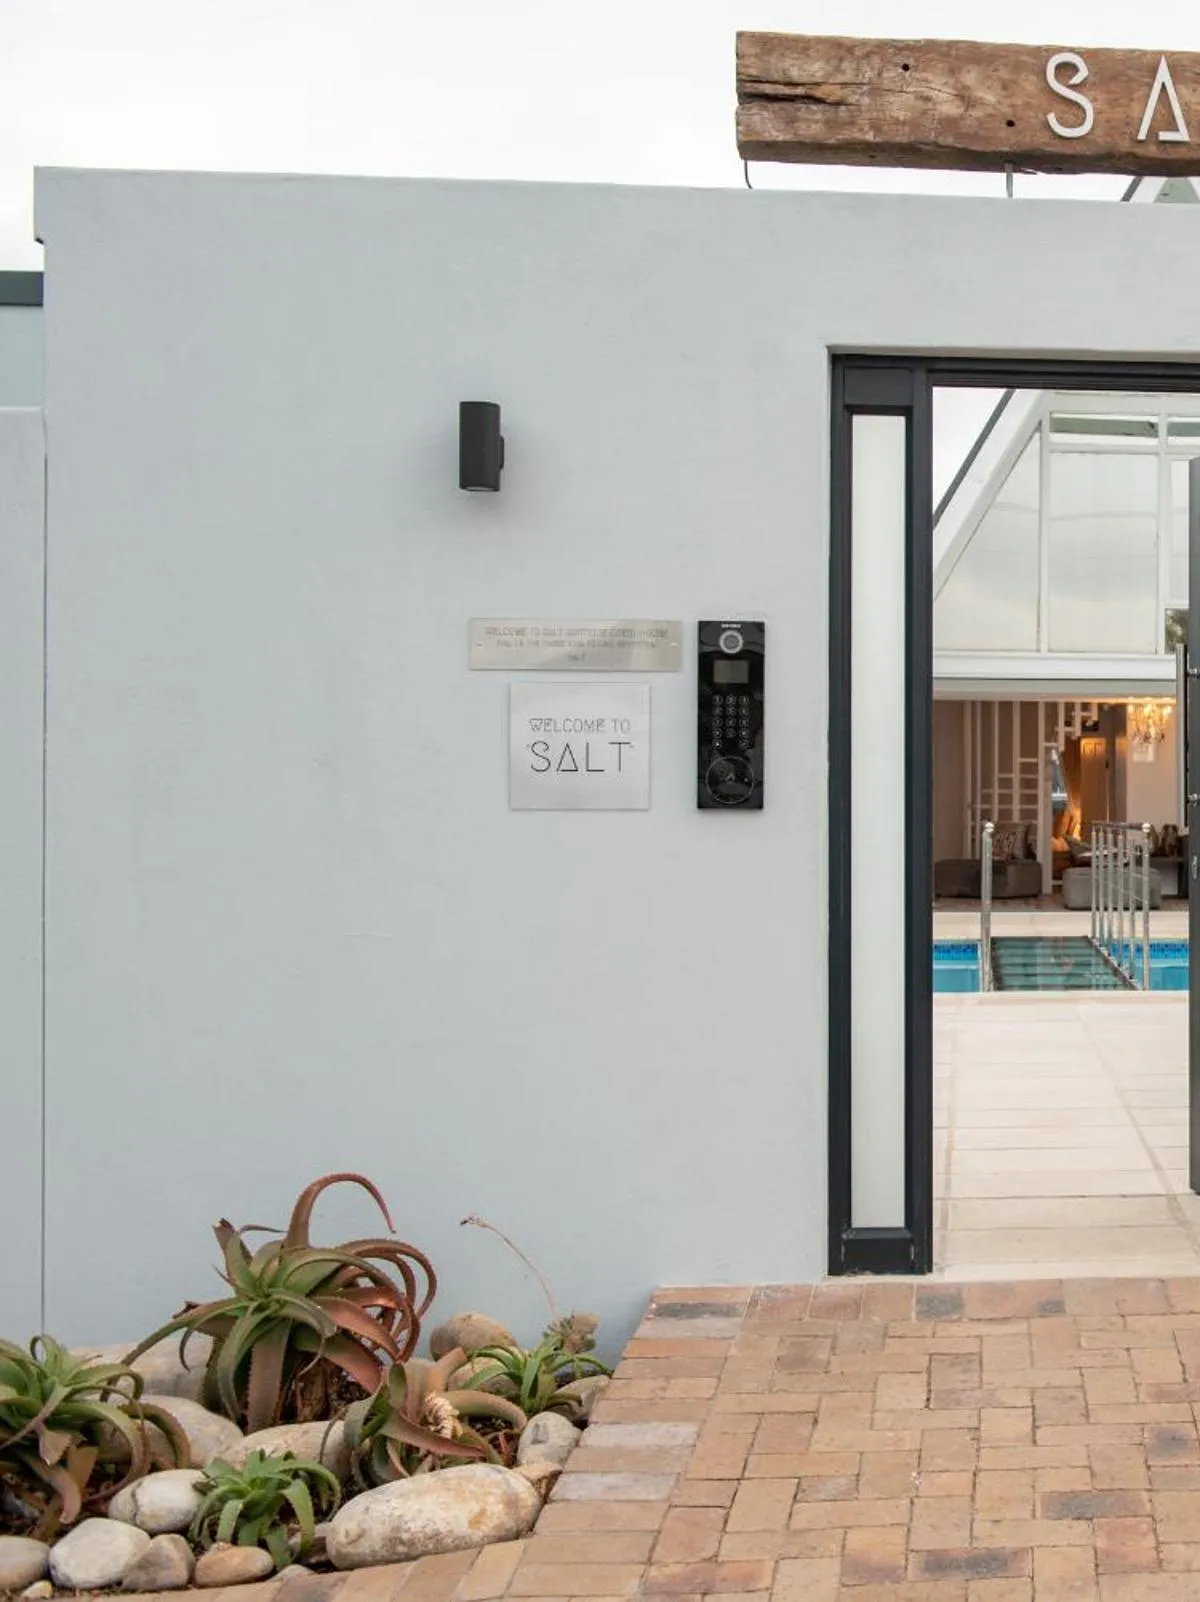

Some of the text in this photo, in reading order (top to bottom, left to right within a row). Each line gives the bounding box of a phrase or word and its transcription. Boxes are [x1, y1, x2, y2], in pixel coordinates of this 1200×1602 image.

[529, 718, 631, 733] WELCOME TO
[530, 740, 631, 772] SALT
